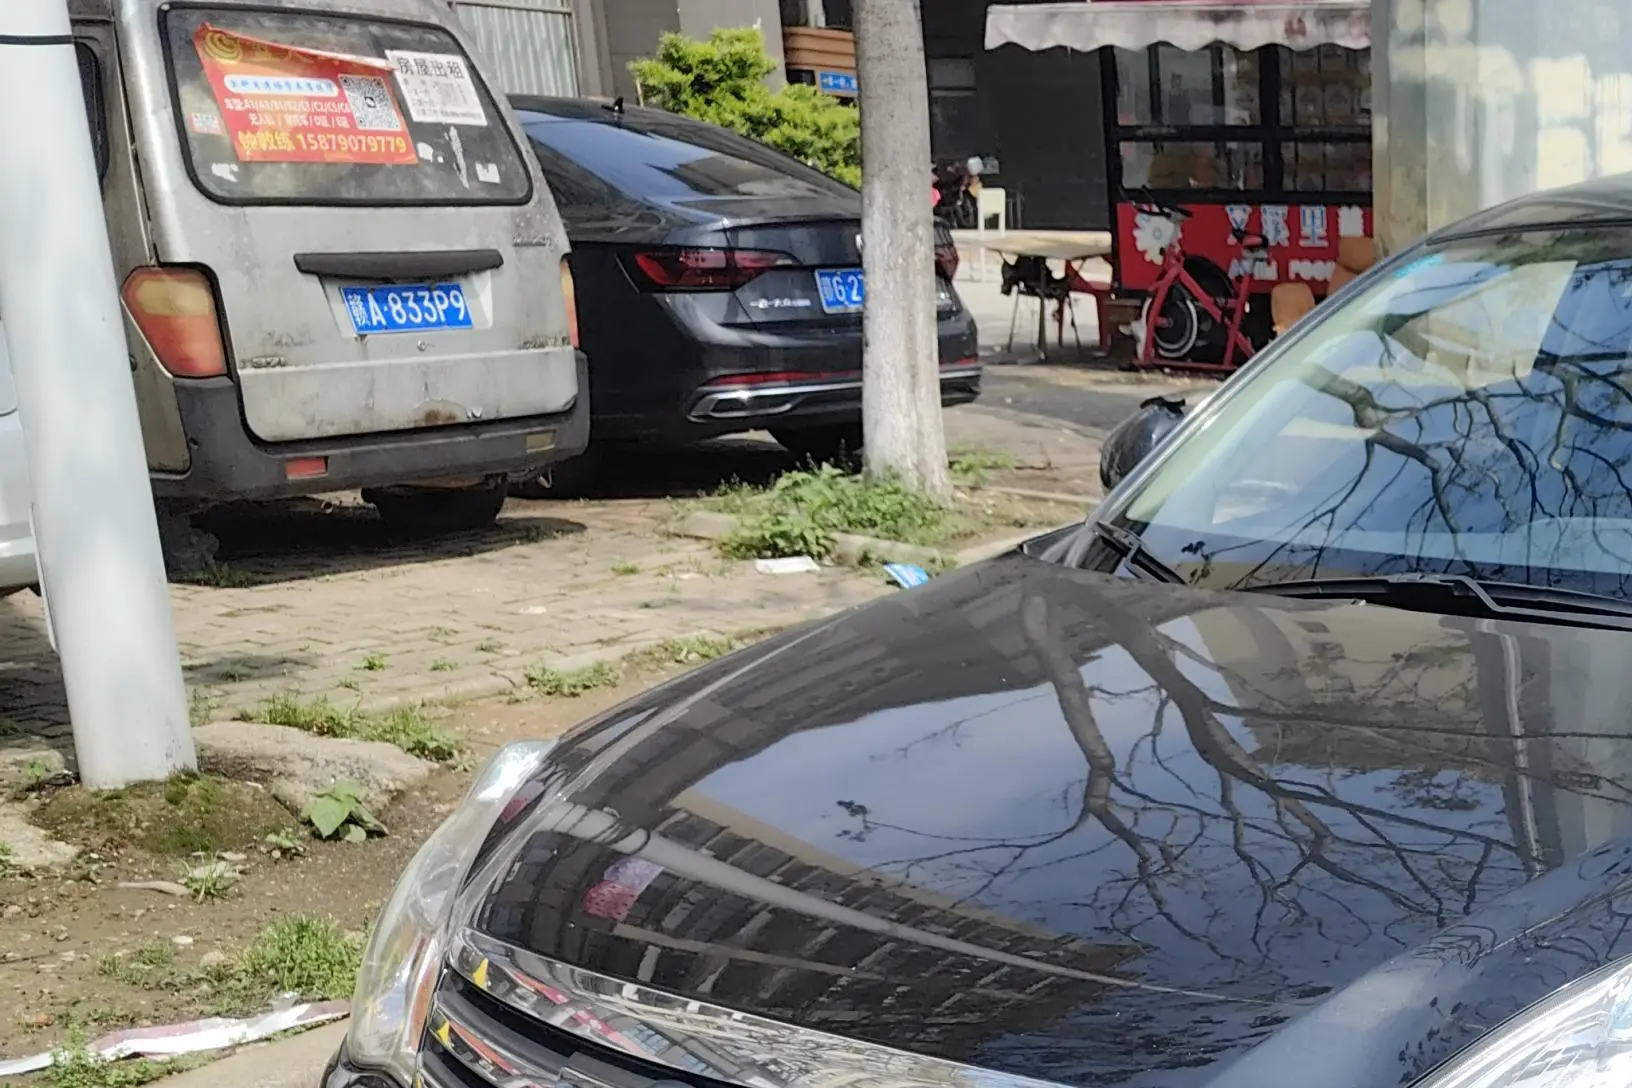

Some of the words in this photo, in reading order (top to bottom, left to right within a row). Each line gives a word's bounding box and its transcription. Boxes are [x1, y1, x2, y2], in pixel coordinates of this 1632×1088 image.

[397, 57, 465, 79] 房屋出租
[296, 132, 407, 153] 15879079779
